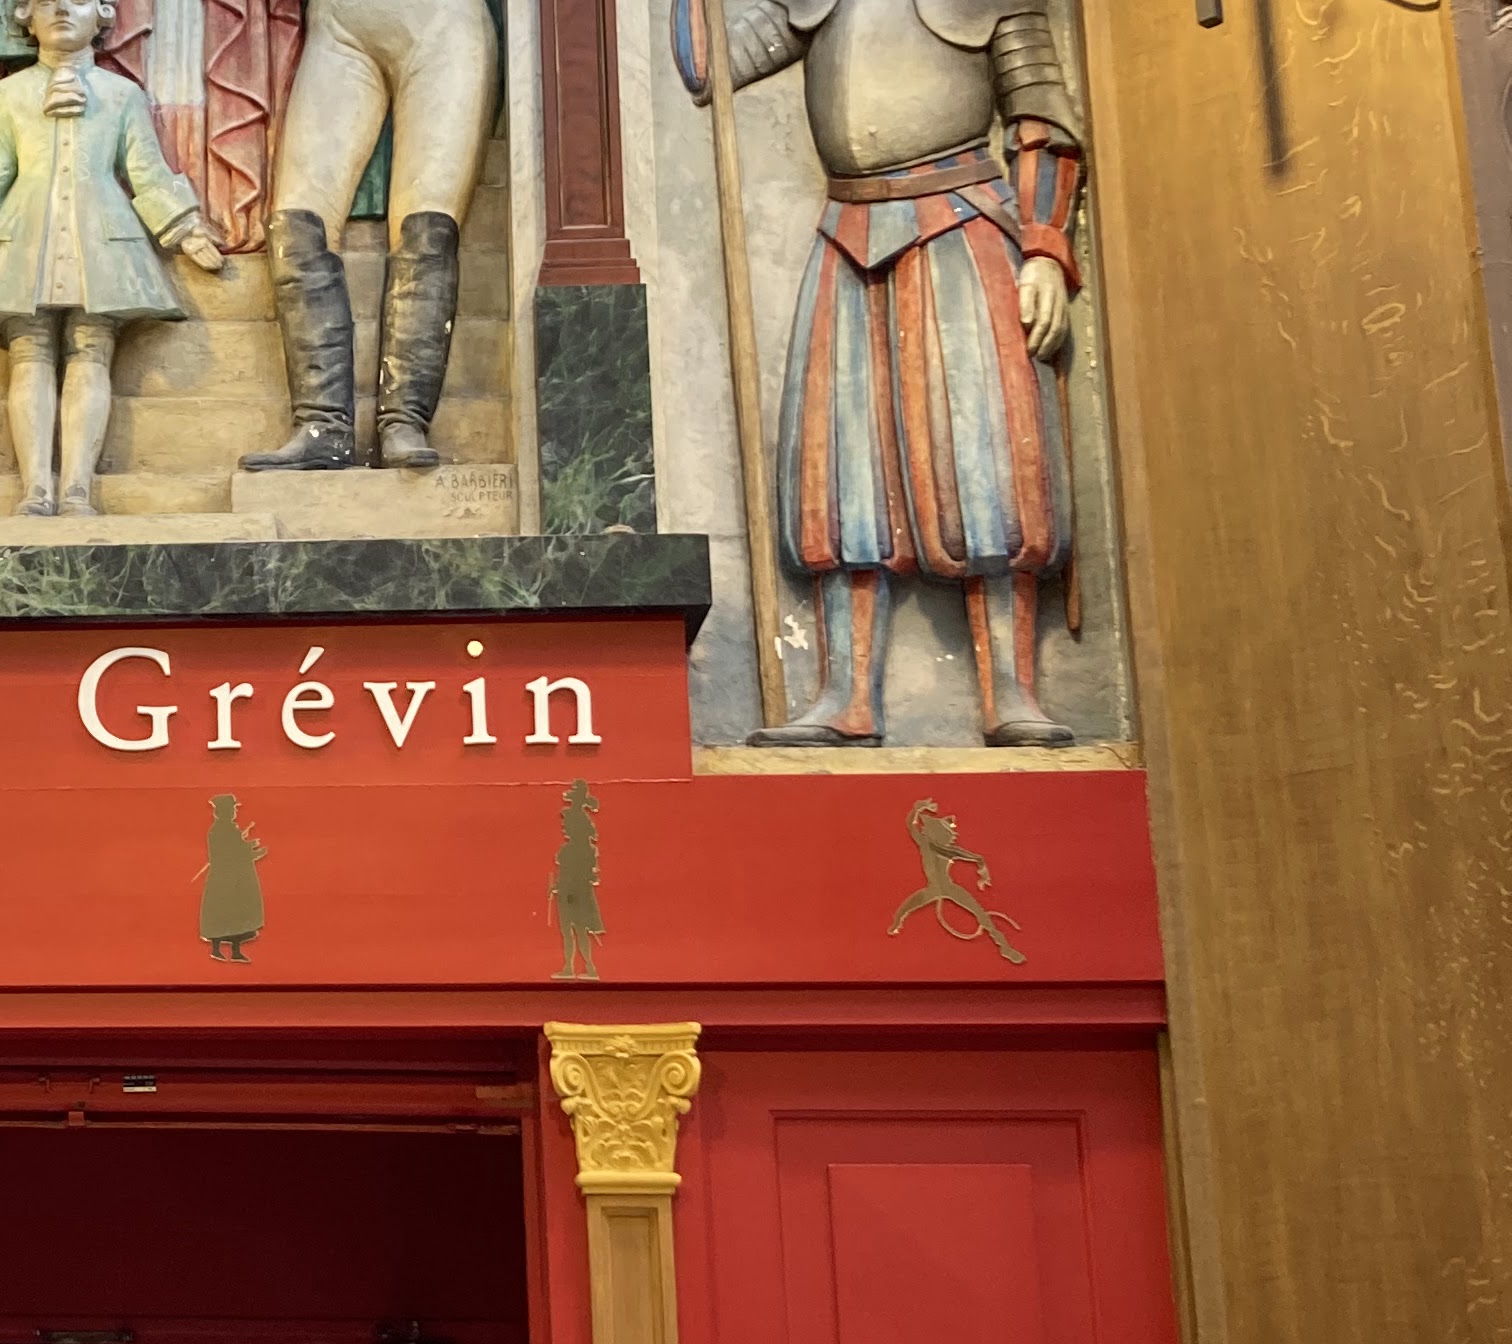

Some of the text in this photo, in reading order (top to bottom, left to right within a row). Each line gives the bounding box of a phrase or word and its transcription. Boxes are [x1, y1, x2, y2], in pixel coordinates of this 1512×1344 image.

[451, 473, 513, 489] BARBIERI
[451, 490, 513, 502] SCULPTEUR
[77, 640, 602, 752] Grévin
